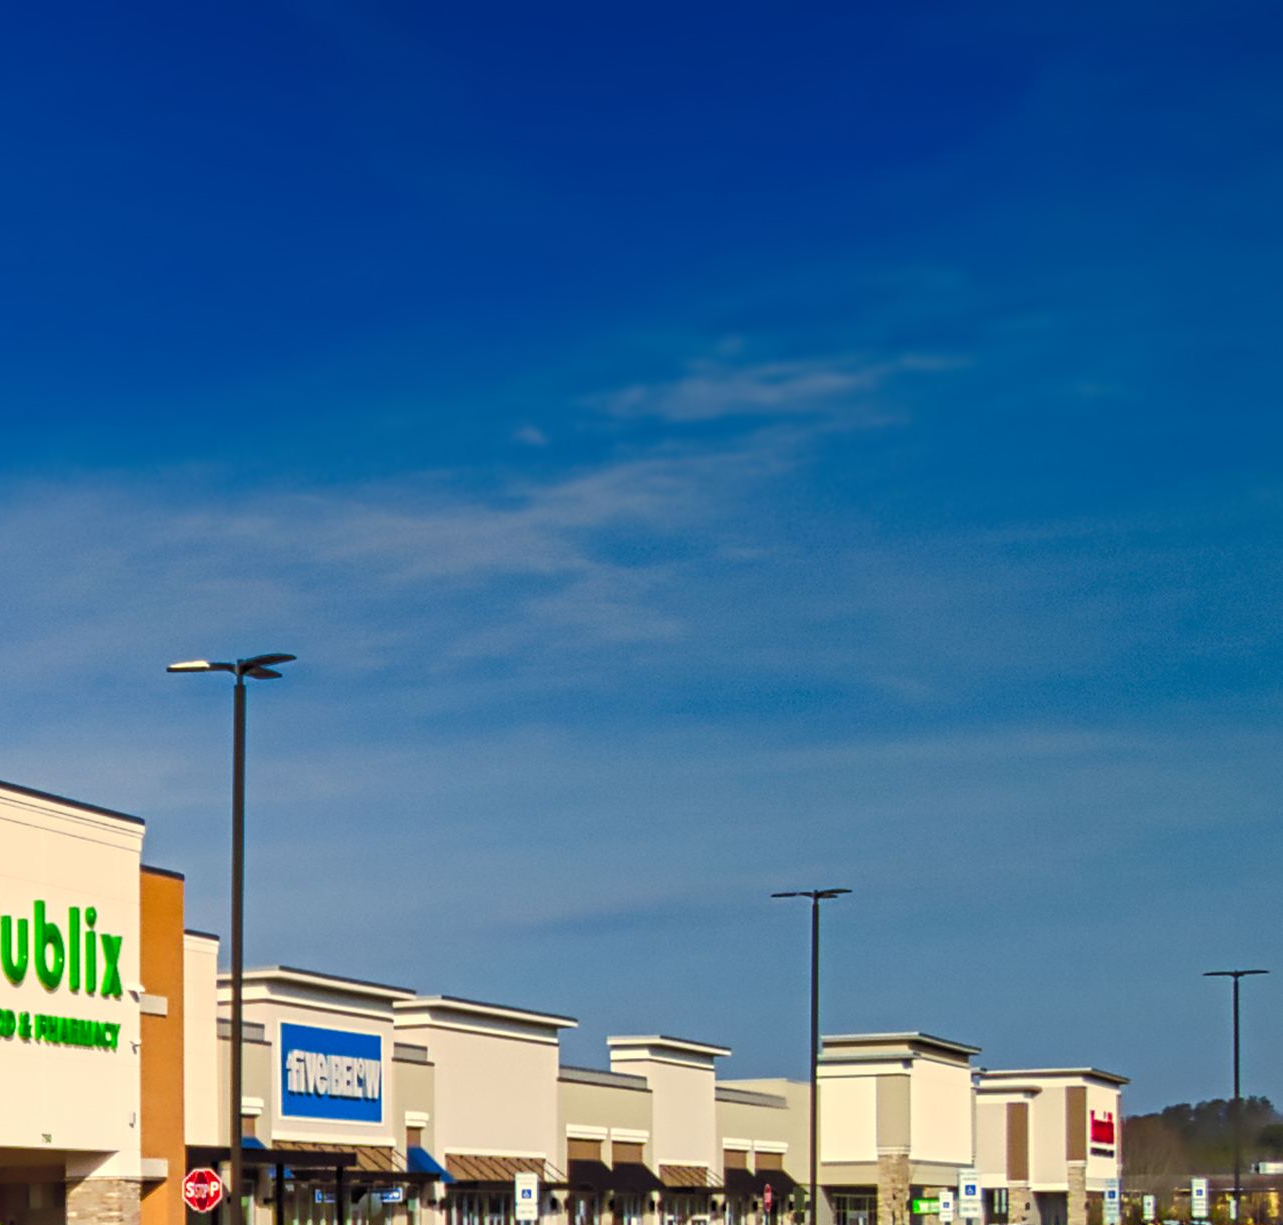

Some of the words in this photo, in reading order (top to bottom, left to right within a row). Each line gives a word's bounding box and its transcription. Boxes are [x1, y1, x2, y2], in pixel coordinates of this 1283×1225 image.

[18, 1011, 32, 1041] &
[34, 1014, 121, 1051] PHARMACY
[327, 1054, 381, 1100] BELOW
